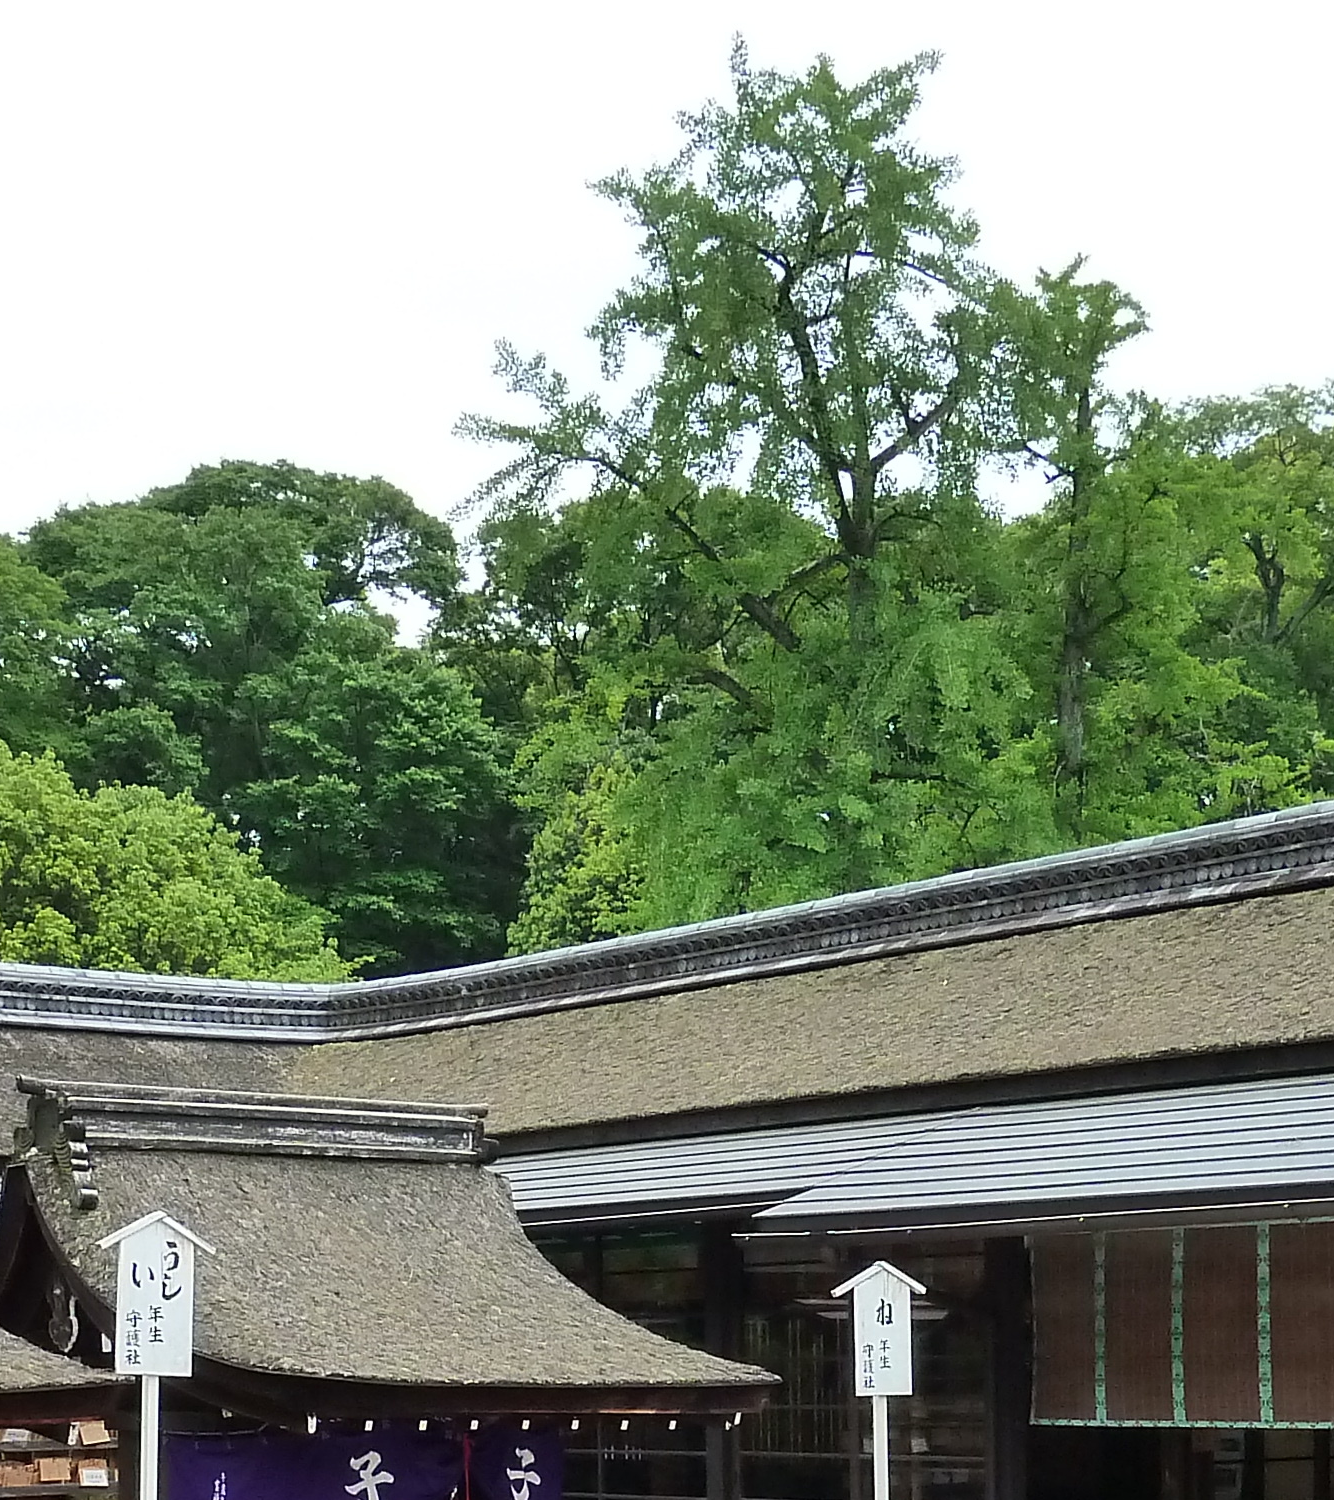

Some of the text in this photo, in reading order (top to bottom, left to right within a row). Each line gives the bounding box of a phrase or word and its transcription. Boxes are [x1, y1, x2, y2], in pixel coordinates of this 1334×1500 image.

[132, 1262, 155, 1288] い
[162, 1241, 182, 1300] うし
[125, 1310, 142, 1365] 守護社
[148, 1305, 164, 1343] 年生
[878, 1339, 892, 1370] 年生
